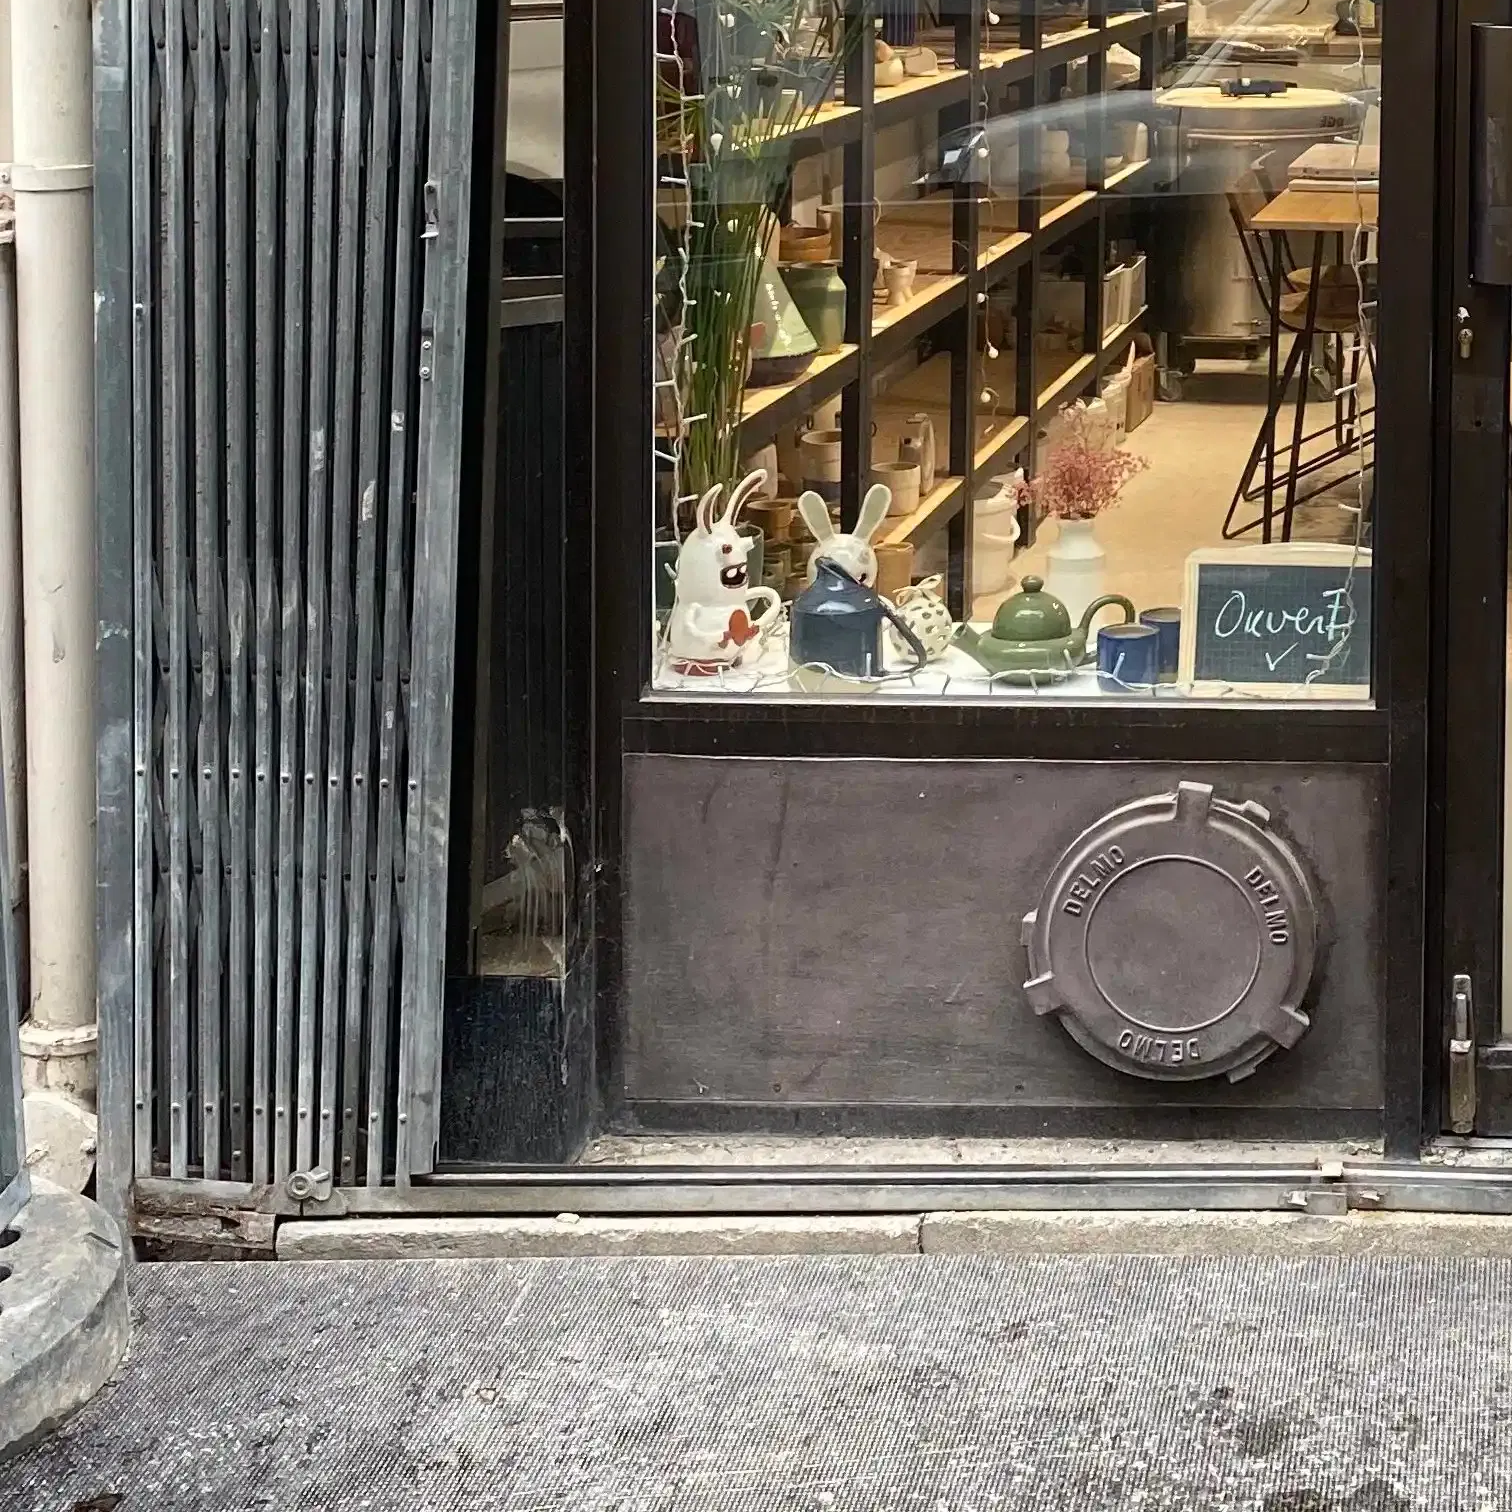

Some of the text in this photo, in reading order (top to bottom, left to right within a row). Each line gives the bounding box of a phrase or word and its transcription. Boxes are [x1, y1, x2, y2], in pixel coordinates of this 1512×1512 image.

[1214, 589, 1347, 642] Ouvert
[1062, 844, 1127, 918] DELMO
[1243, 864, 1289, 946] DELMO
[1117, 1028, 1200, 1064] DELMO
